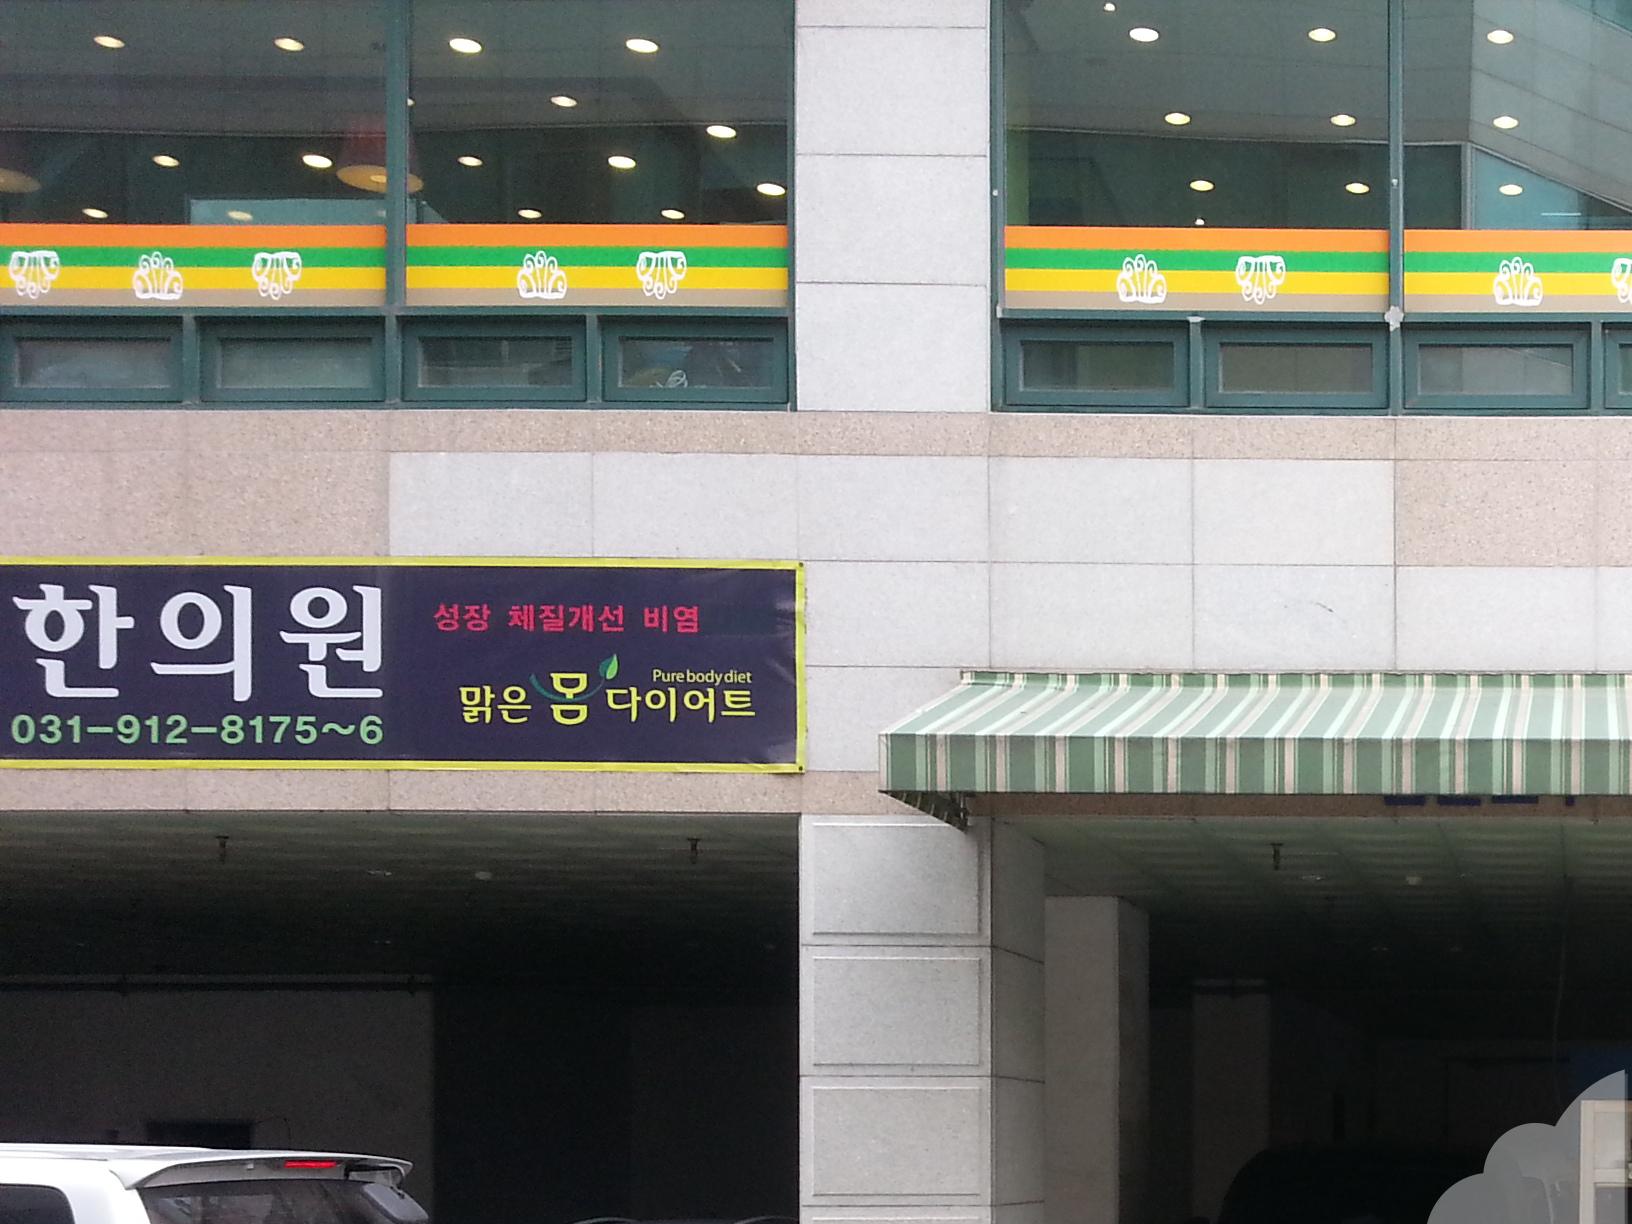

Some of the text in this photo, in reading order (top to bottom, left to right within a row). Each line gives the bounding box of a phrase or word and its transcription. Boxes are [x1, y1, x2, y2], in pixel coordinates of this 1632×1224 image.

[433, 603, 701, 634] 성장 체질개선 비염
[12, 583, 384, 702] 한의원
[652, 668, 753, 685] Pure body diet
[458, 672, 756, 725] 맑은 몸 다이어트
[11, 713, 384, 746] 031-912-8175~6
